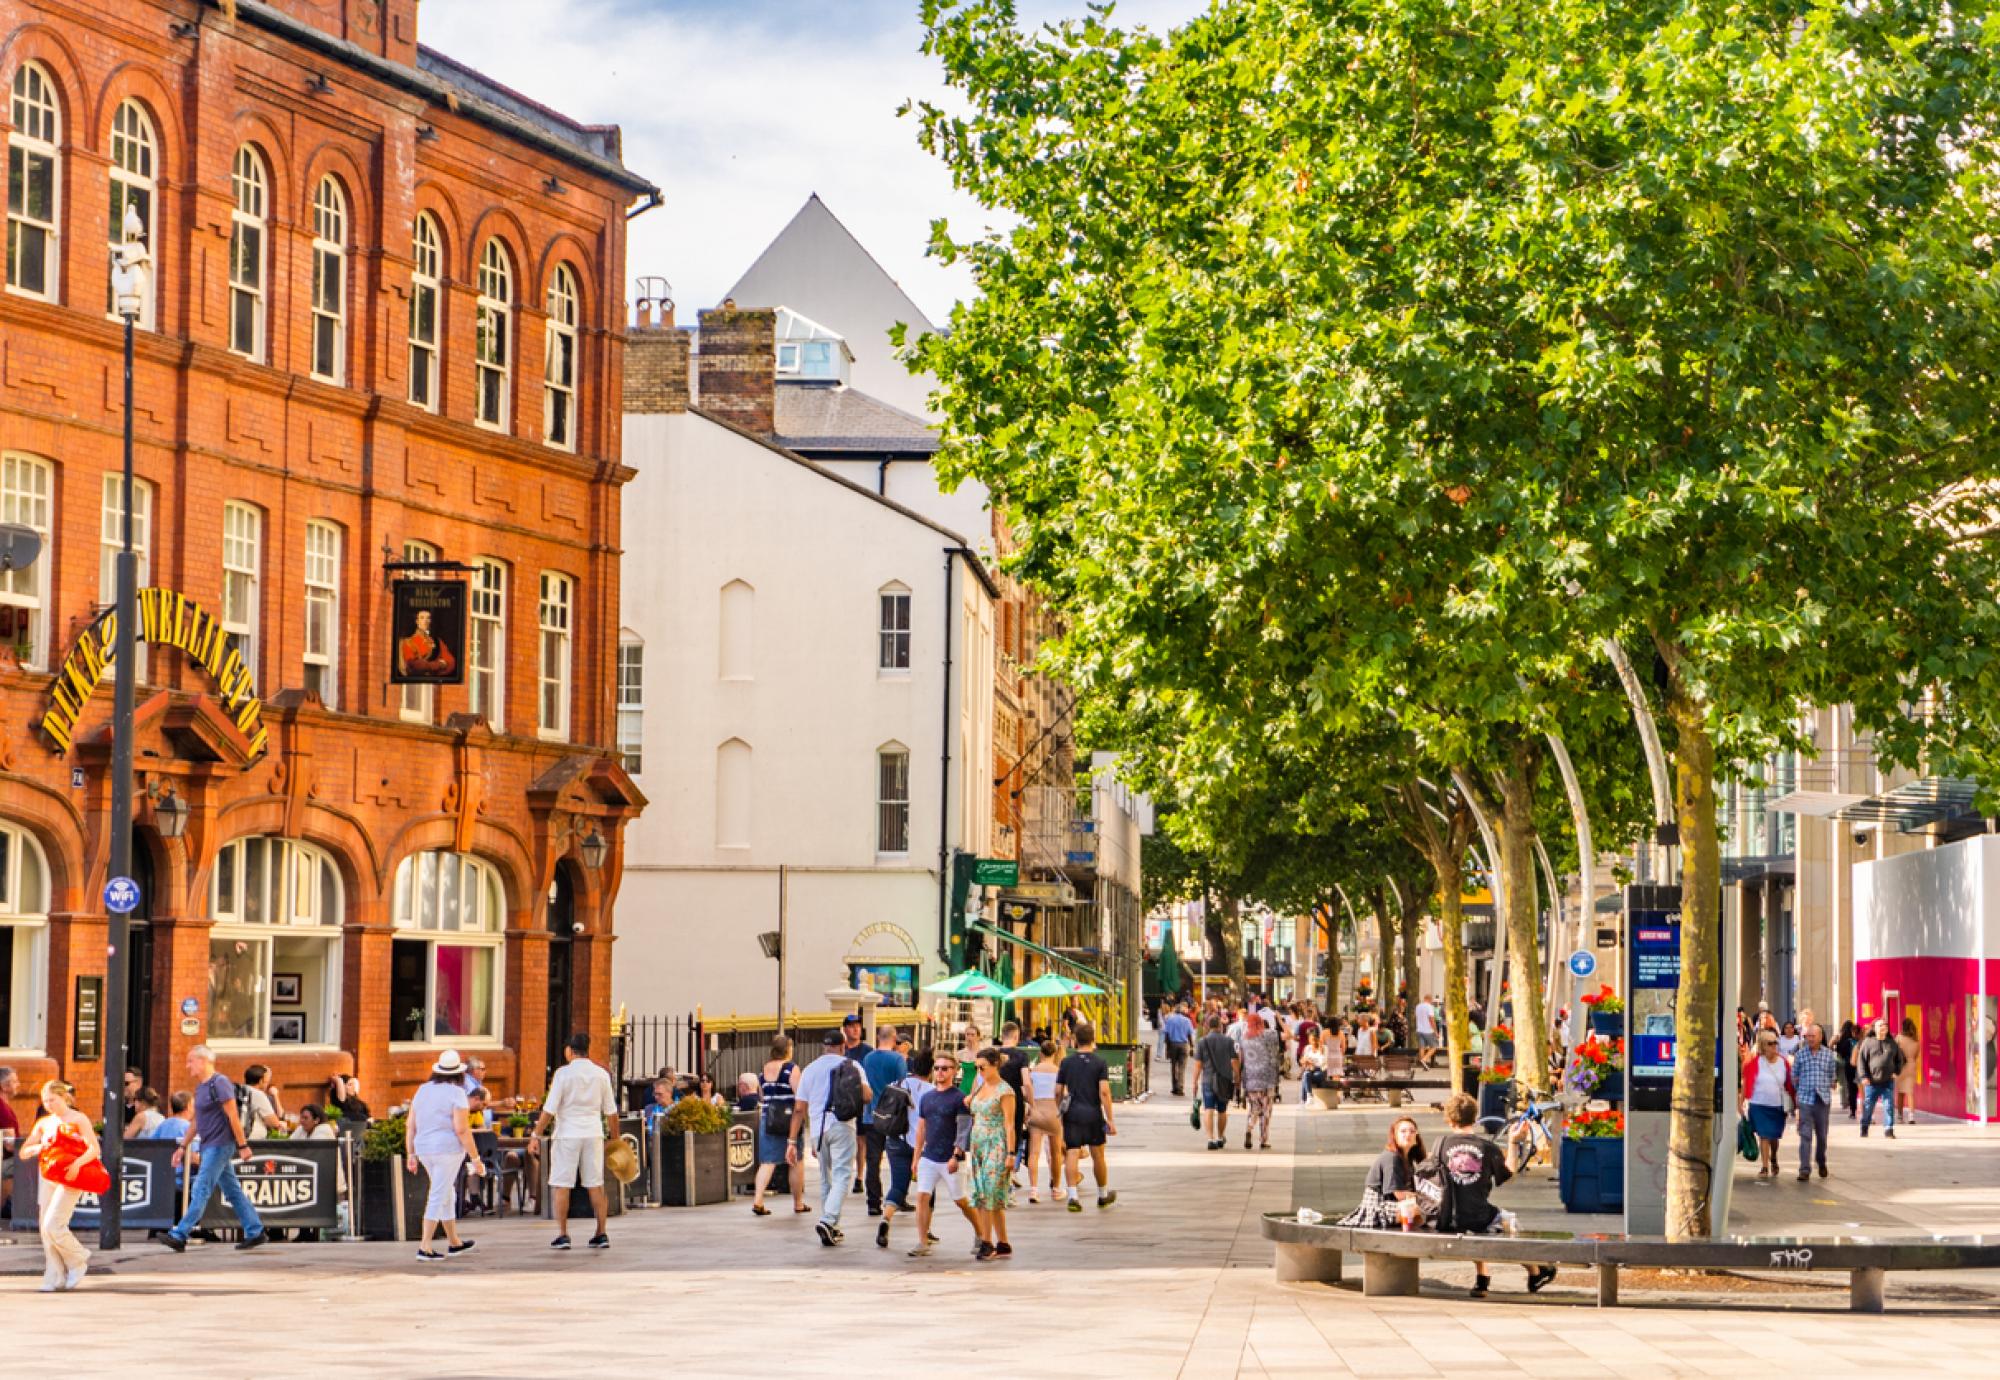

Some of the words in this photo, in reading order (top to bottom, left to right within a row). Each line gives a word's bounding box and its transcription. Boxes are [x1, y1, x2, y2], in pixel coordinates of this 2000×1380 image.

[42, 630, 102, 752] DUKE
[138, 587, 268, 759] WELLINGTON
[241, 1179, 311, 1206] RAINS
